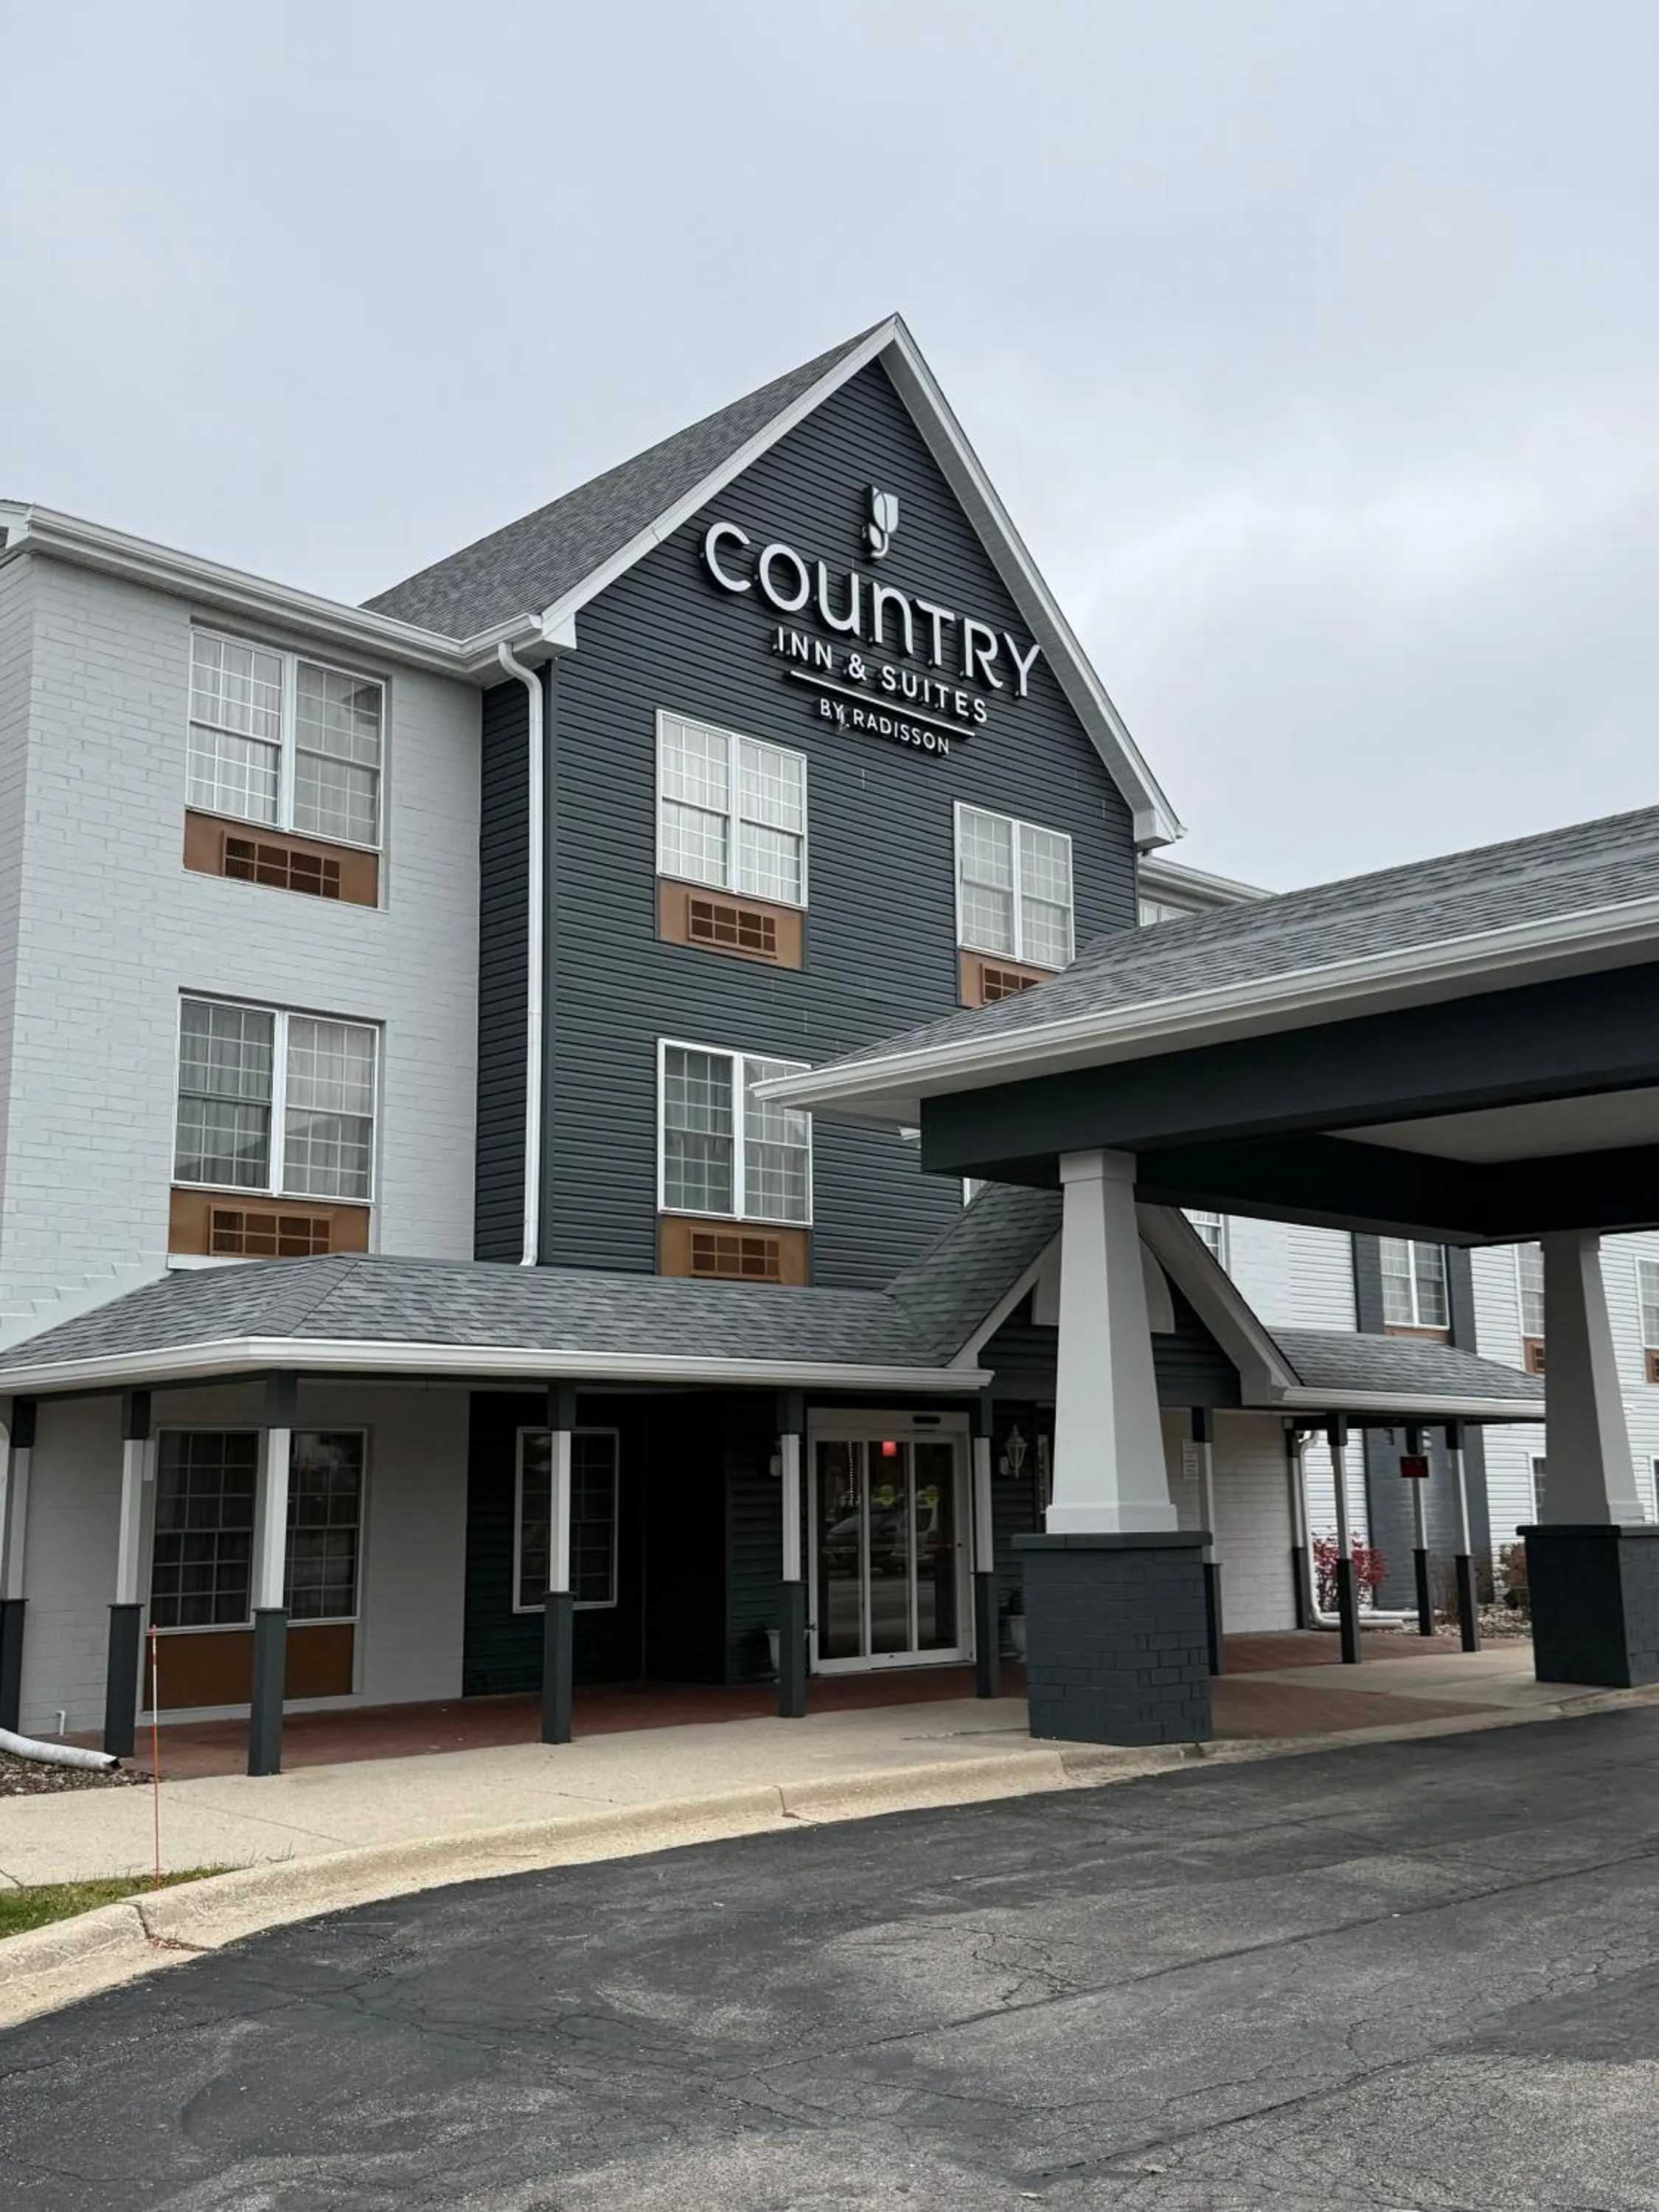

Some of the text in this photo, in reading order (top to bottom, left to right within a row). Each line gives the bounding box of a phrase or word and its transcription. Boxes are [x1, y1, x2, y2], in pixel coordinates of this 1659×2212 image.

[776, 626, 988, 723] INN & SUITES
[820, 698, 950, 755] BY RADISSON
